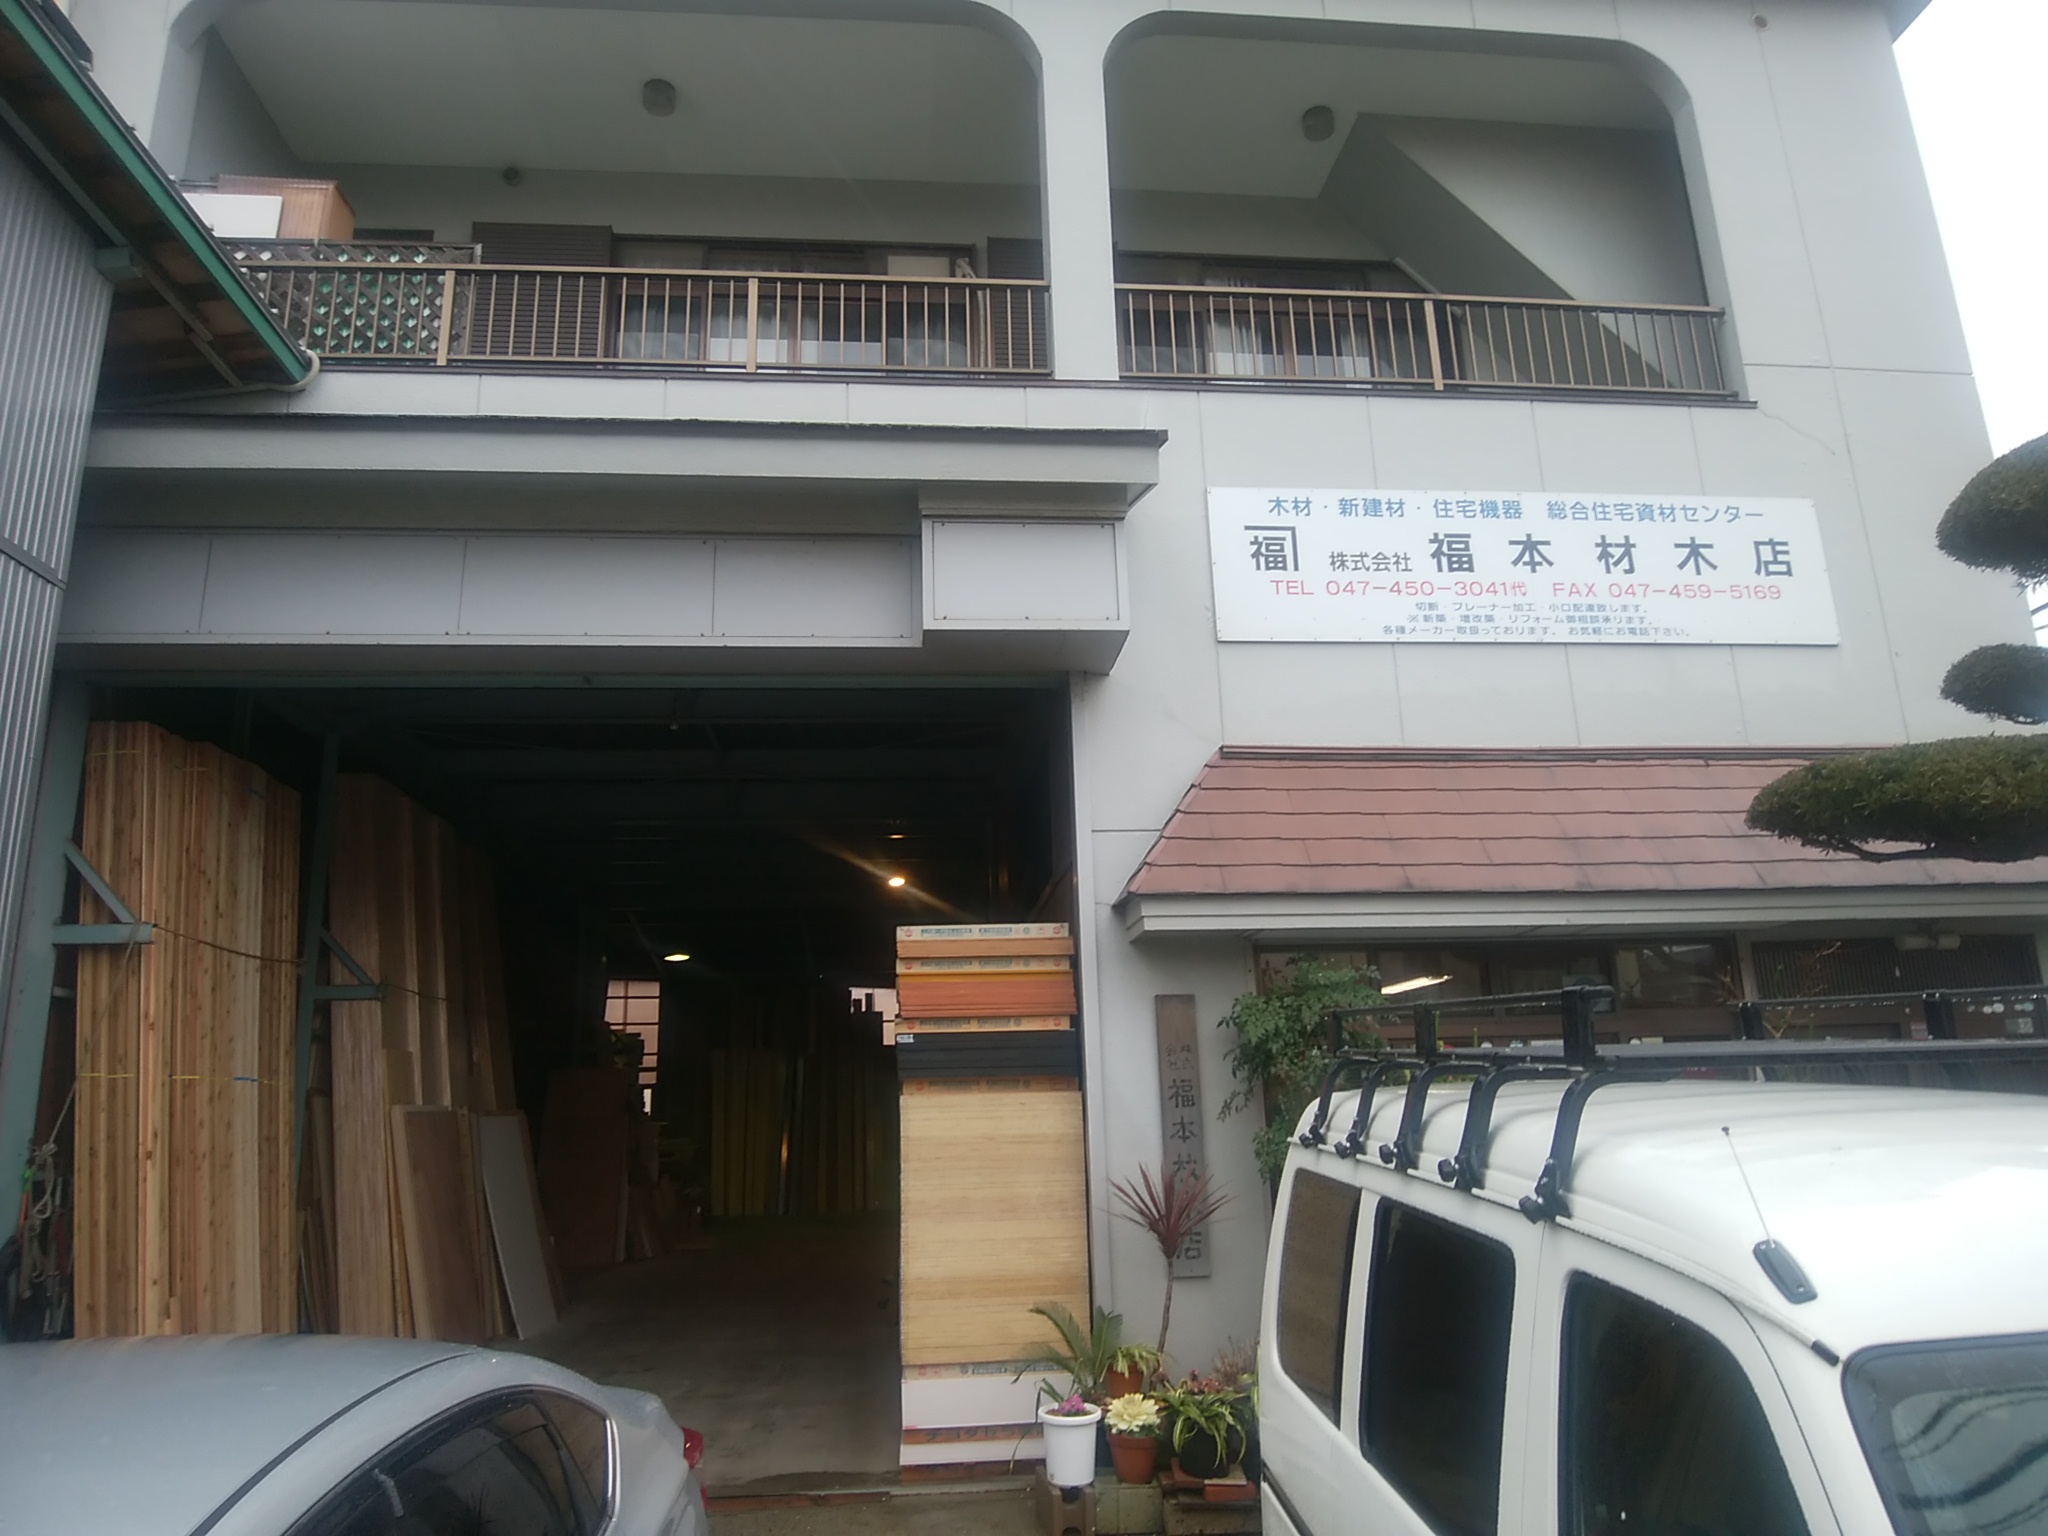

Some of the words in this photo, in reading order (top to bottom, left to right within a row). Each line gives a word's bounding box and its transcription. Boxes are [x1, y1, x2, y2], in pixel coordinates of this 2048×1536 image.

[1546, 500, 1763, 524] 総合住宅資材センター
[1248, 534, 1289, 572] 福
[1329, 551, 1413, 572] 株式会社
[1428, 532, 1794, 577] 福本材木店
[1270, 580, 1314, 596] TEL
[1553, 582, 1598, 598] FAX
[1609, 583, 1782, 600] 047-459-5169
[1168, 1079, 1202, 1260] 福本材店
